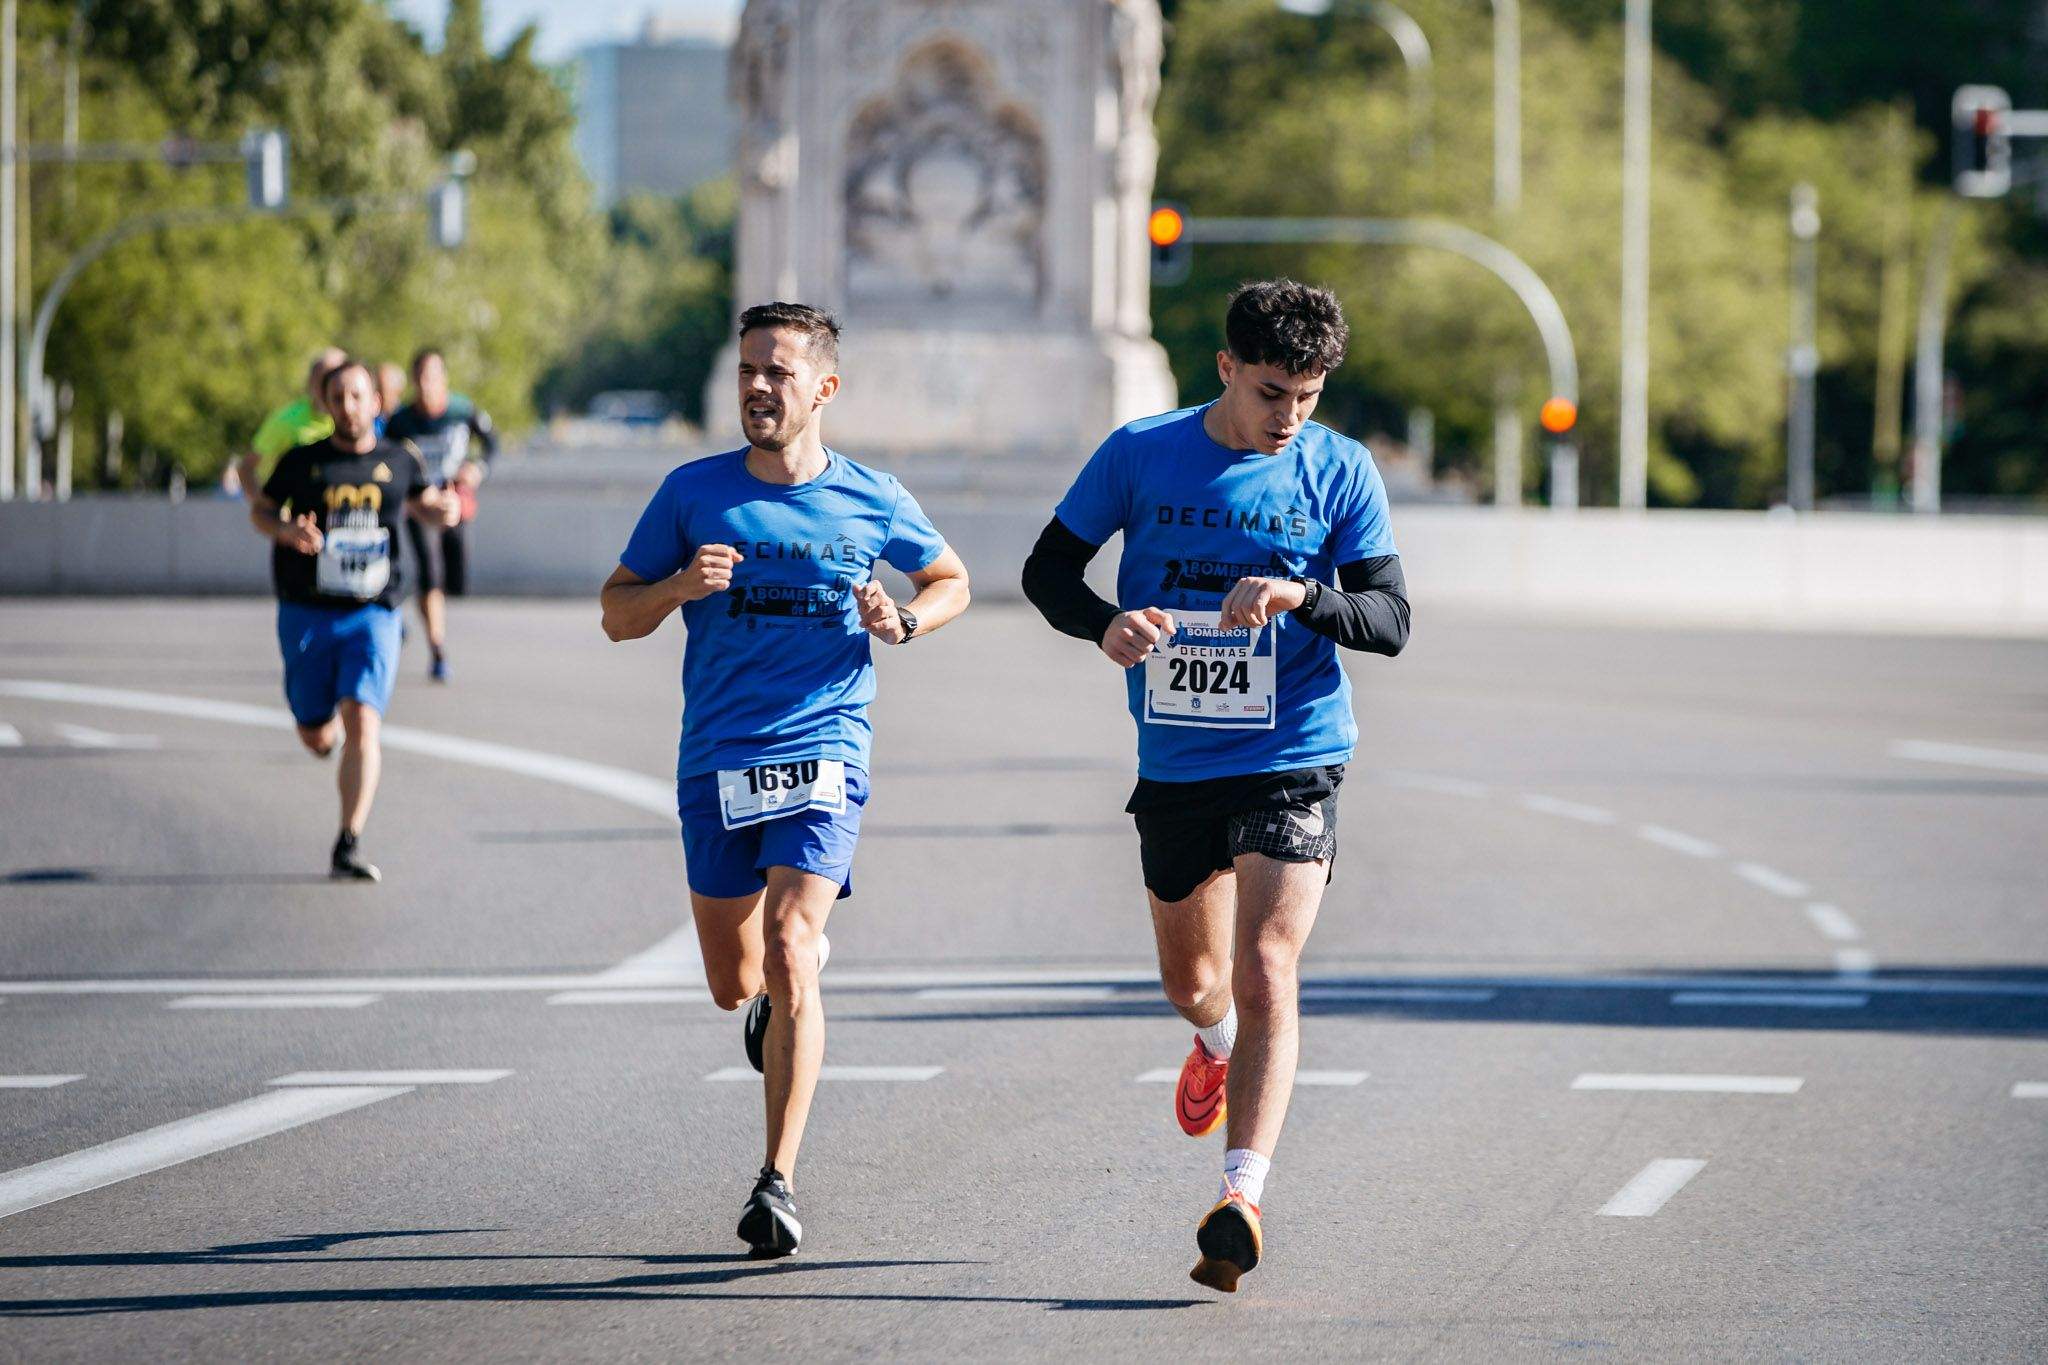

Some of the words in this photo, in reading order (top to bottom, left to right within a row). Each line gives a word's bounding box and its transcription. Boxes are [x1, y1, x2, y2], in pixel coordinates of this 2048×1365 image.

[1158, 506, 1307, 537] DECIMAS
[734, 541, 857, 562] ECIMAS
[1190, 561, 1284, 578] BOMBEROS
[757, 587, 846, 602] BOMBEROS
[1187, 628, 1249, 638] BOMBEROS
[1181, 646, 1248, 658] DECIMAS
[1169, 657, 1251, 694] 2024
[743, 759, 819, 795] 1630
